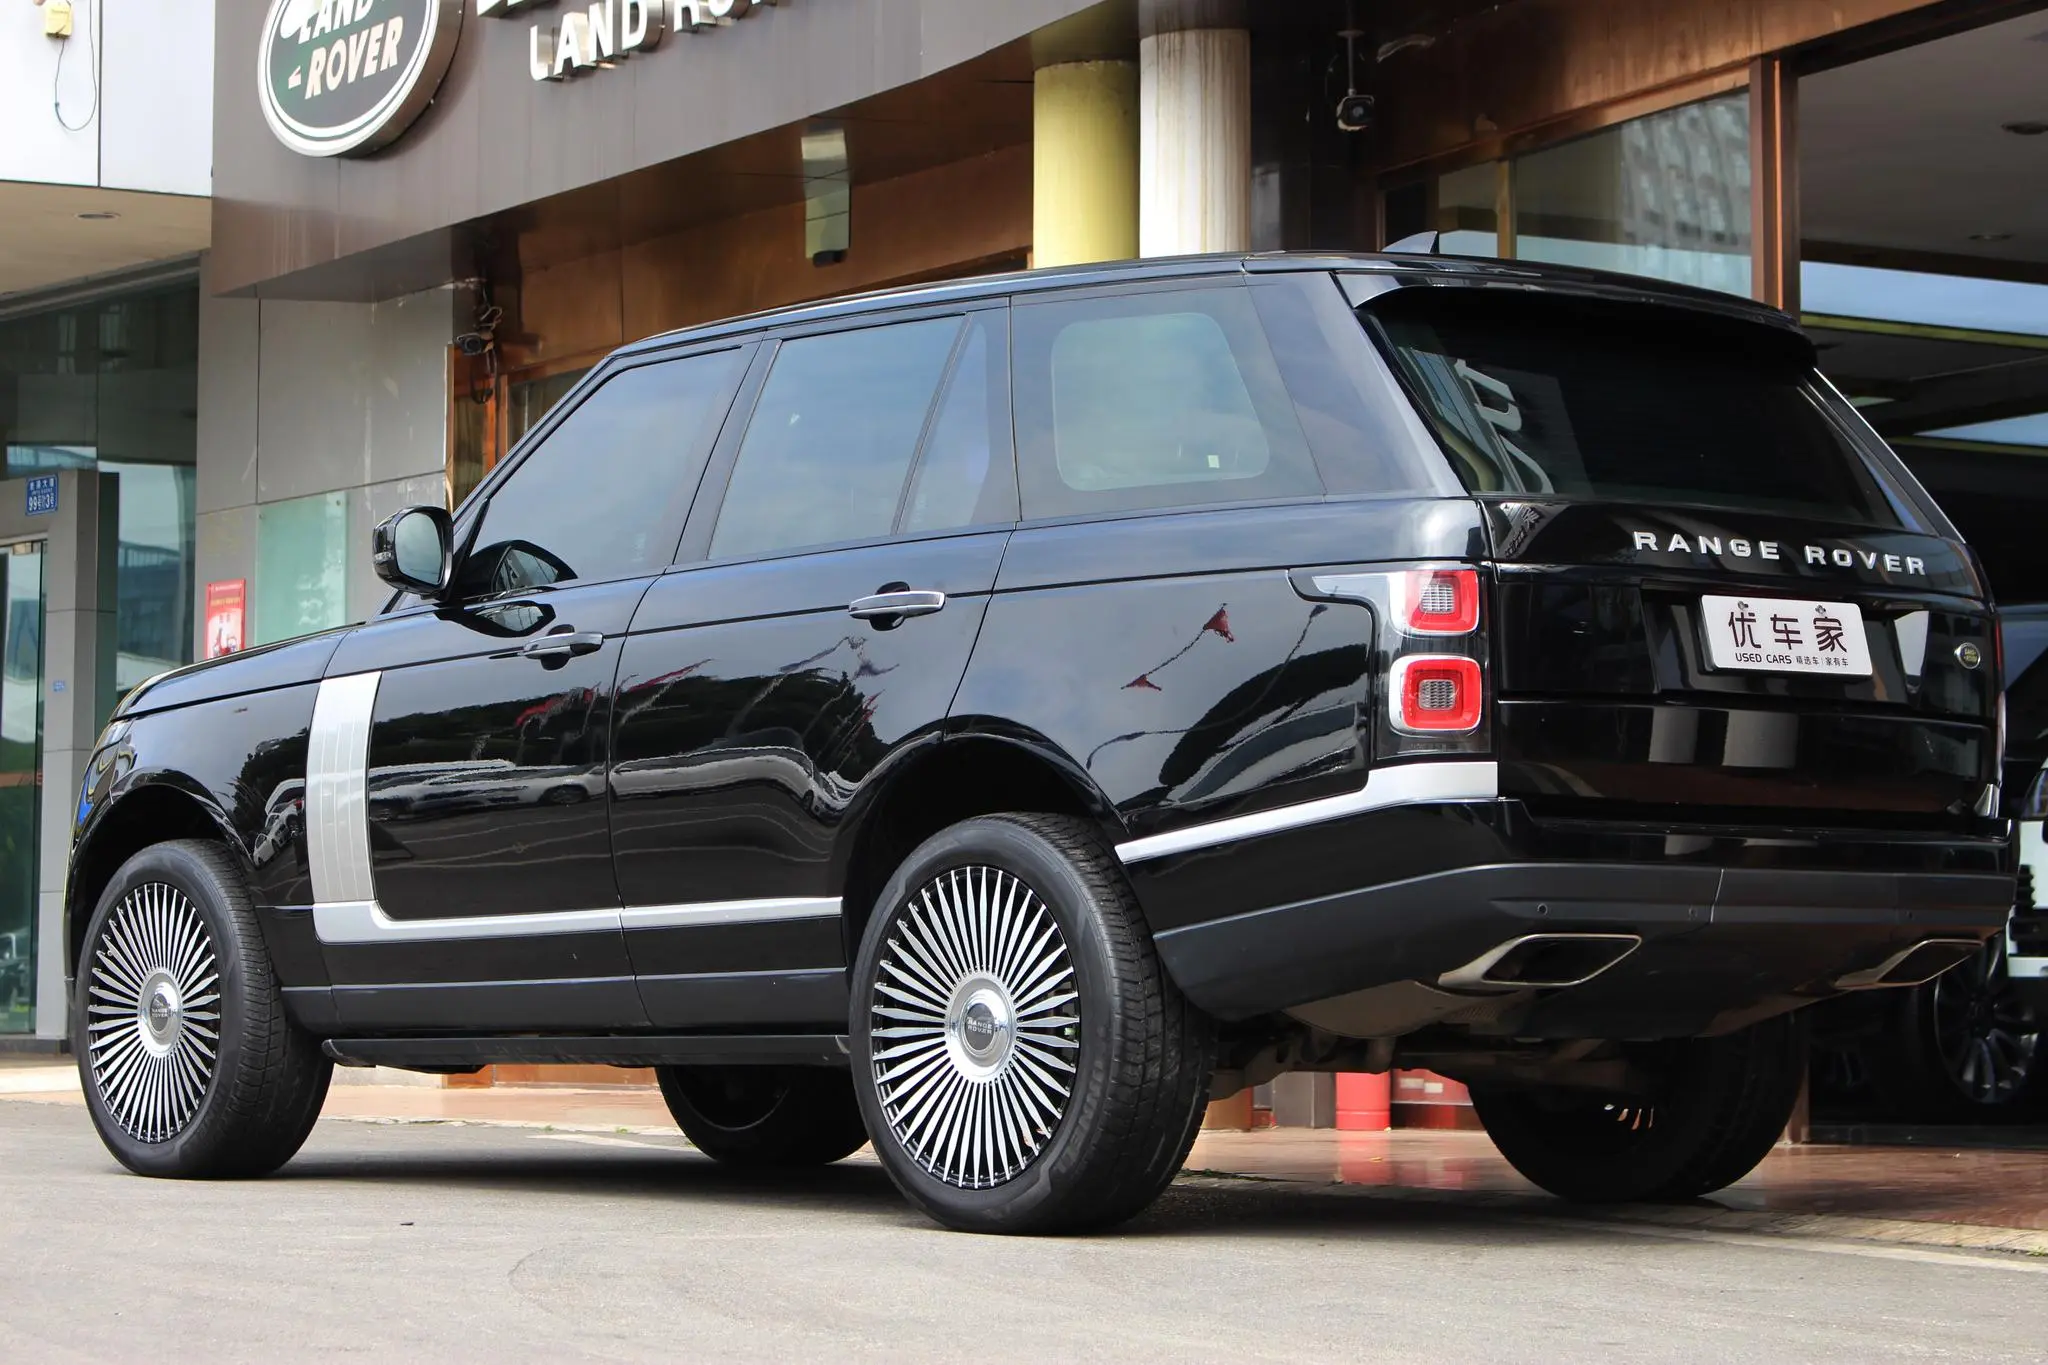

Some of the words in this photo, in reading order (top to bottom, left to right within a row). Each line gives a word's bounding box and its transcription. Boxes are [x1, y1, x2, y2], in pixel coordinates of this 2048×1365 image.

[304, 16, 404, 100] ROVER
[530, 0, 649, 81] LAND
[1633, 530, 1780, 560] RANGE
[1805, 544, 1926, 576] ROVER
[1728, 611, 1847, 652] 优车家
[1735, 652, 1762, 663] USED
[1766, 654, 1792, 665] CARS
[966, 1016, 993, 1030] RANGE
